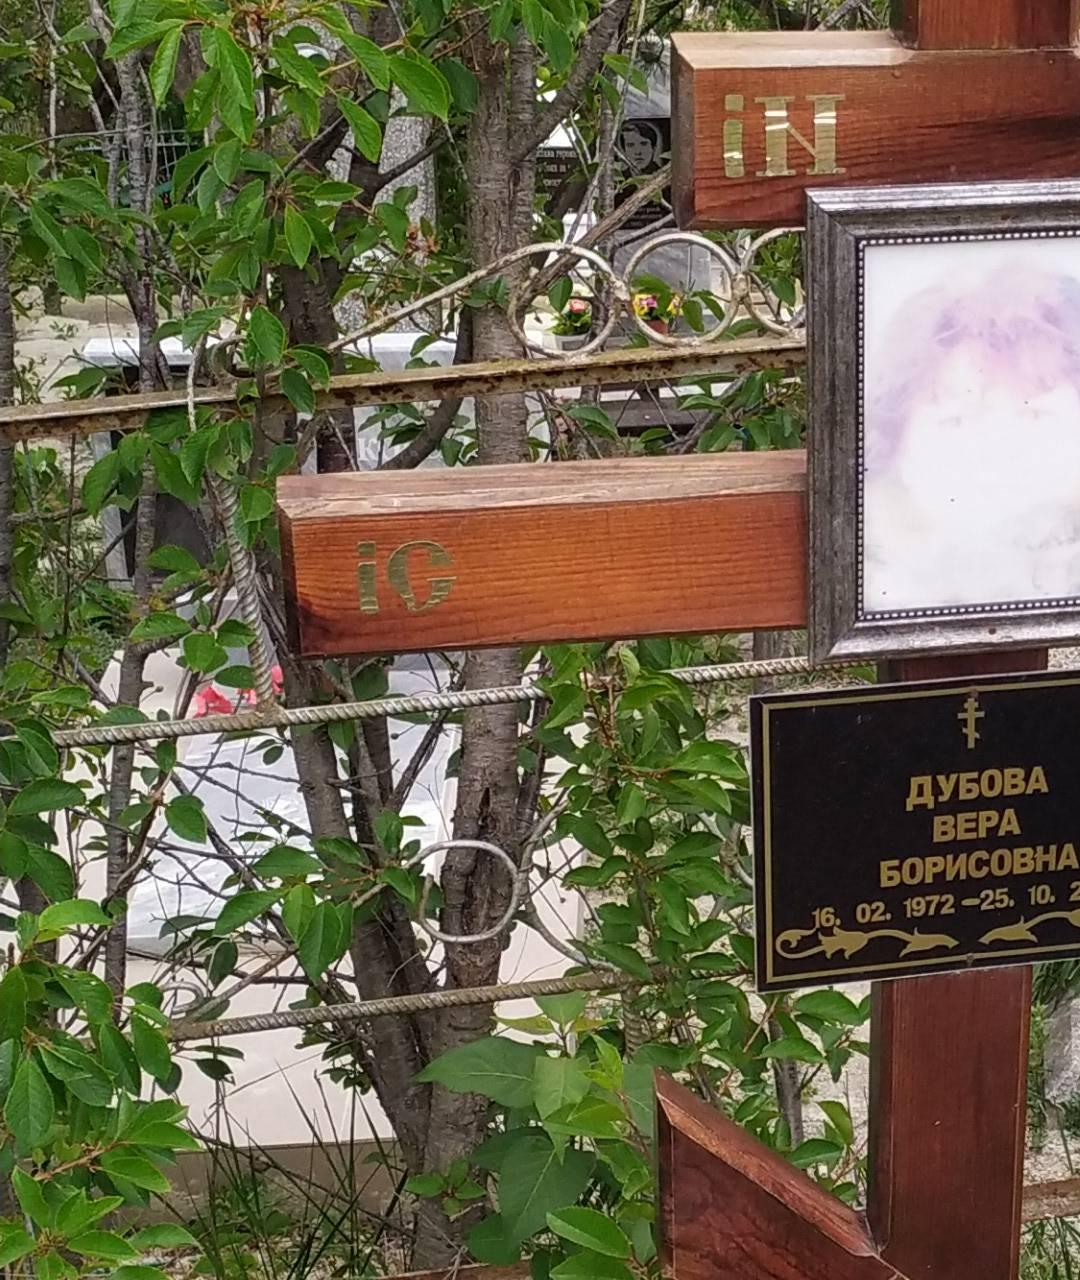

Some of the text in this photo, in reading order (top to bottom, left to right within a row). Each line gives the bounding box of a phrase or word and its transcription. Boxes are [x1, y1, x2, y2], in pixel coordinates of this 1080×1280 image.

[905, 766, 1049, 811] ДУБОВА
[932, 809, 1021, 843] ВЕРА
[879, 843, 1079, 888] БОРИСОВНА
[855, 901, 891, 924] 02.
[903, 889, 955, 919] 1972
[1028, 884, 1056, 905] 10.
